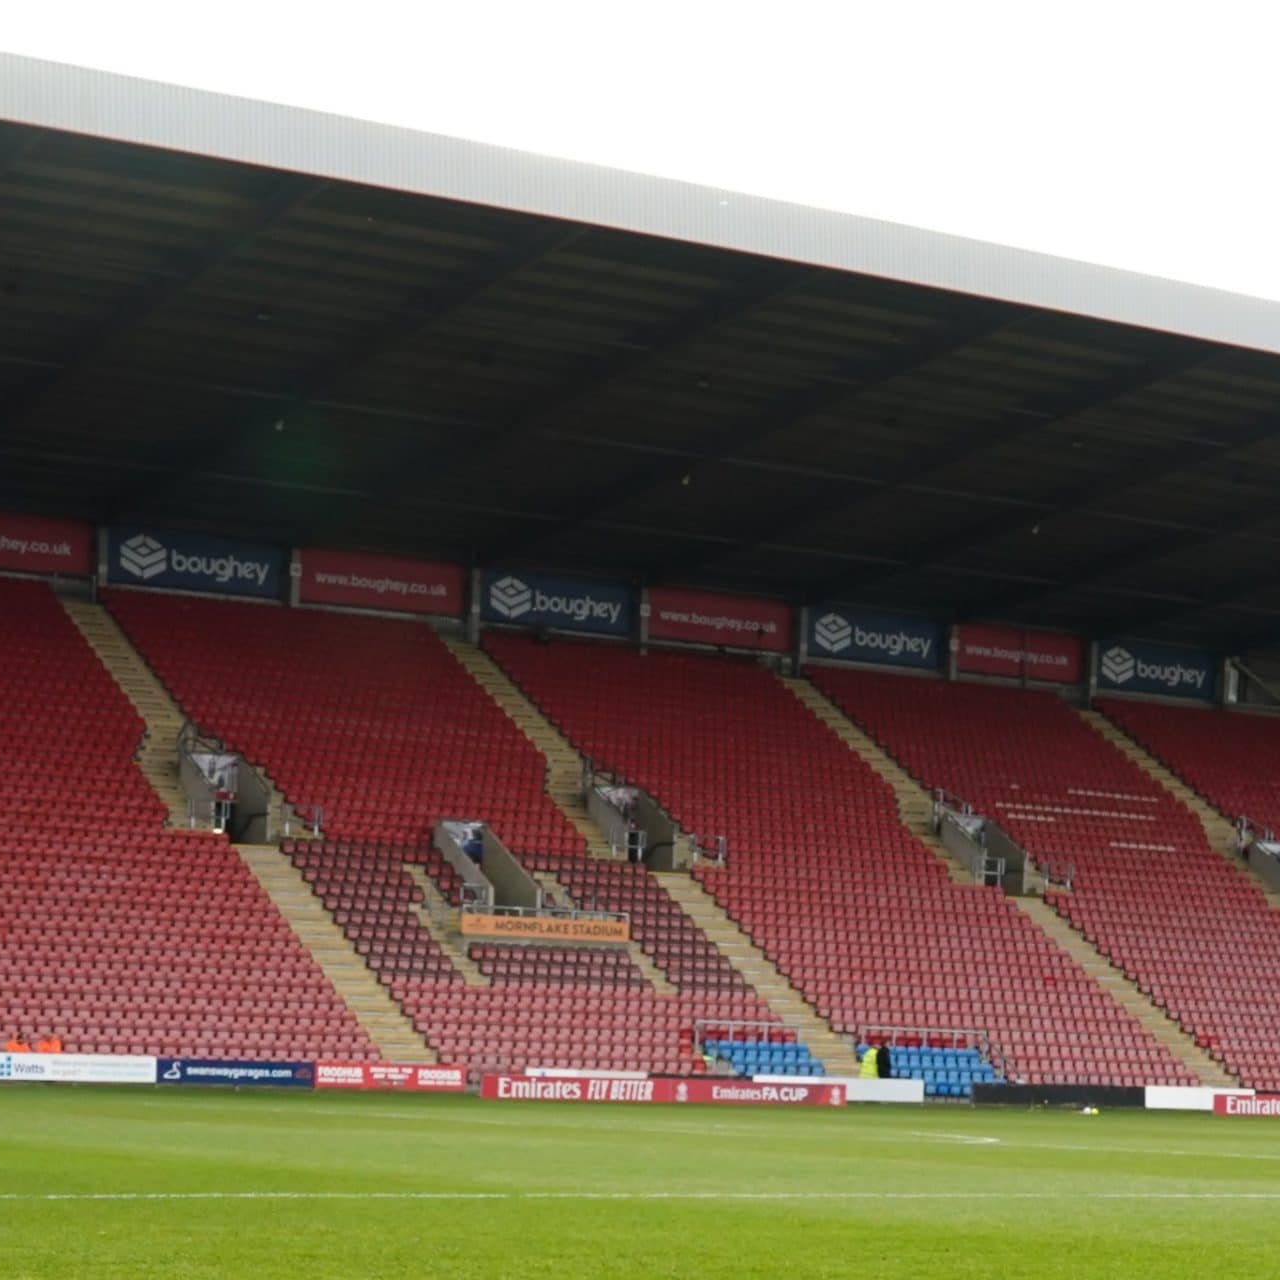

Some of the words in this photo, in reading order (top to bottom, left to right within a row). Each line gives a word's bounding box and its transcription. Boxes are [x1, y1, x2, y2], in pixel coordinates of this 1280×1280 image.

[172, 550, 270, 586] boughey
[315, 572, 447, 597] www.boughey.co.uk
[536, 590, 620, 624] boughey
[855, 627, 931, 658] boughey
[1137, 658, 1205, 688] boughey
[494, 920, 569, 934] MORNFLAKE
[573, 924, 623, 937] STADIUM
[14, 1064, 45, 1074] Watts
[498, 1077, 581, 1099] Emirates
[587, 1080, 609, 1100] FLY
[610, 1080, 654, 1101] BETTER
[712, 1086, 761, 1100] Emirates
[762, 1087, 779, 1101] FA
[780, 1088, 808, 1102] CUP
